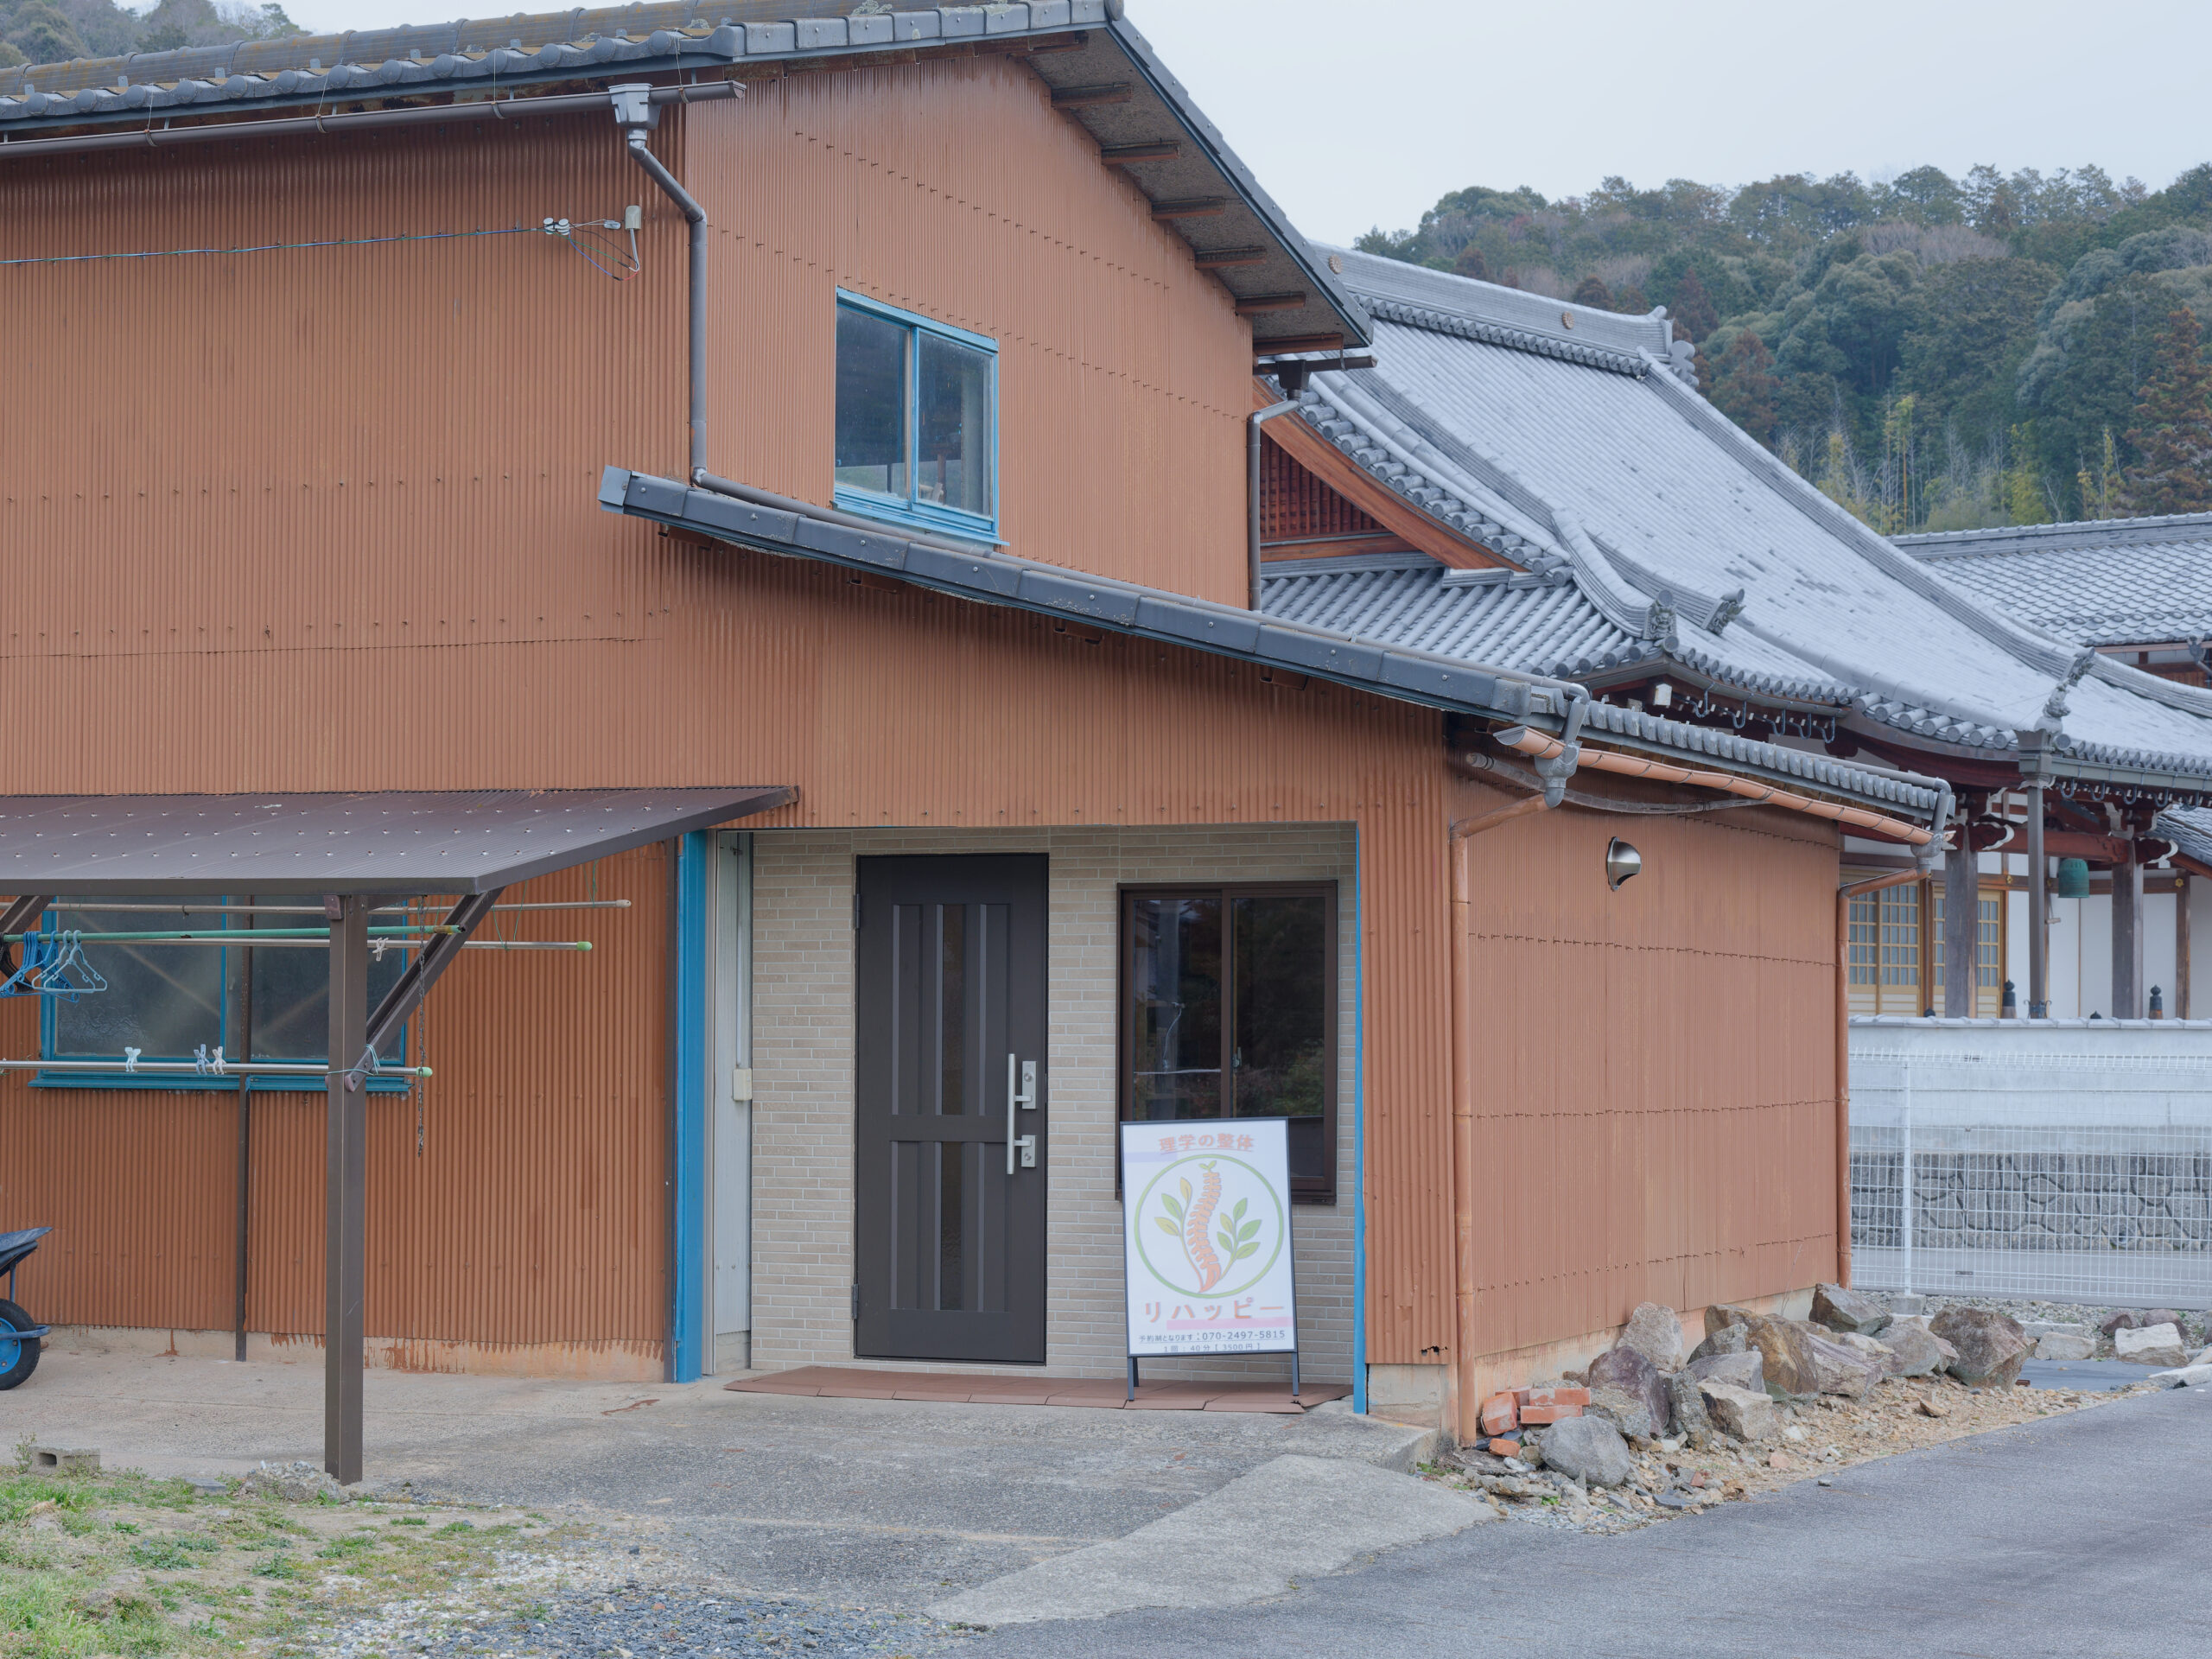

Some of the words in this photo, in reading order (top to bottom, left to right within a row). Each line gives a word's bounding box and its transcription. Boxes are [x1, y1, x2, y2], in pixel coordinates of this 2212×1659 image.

[1159, 1133, 1254, 1151] 理学の整体
[1145, 1297, 1284, 1323] リハッピー
